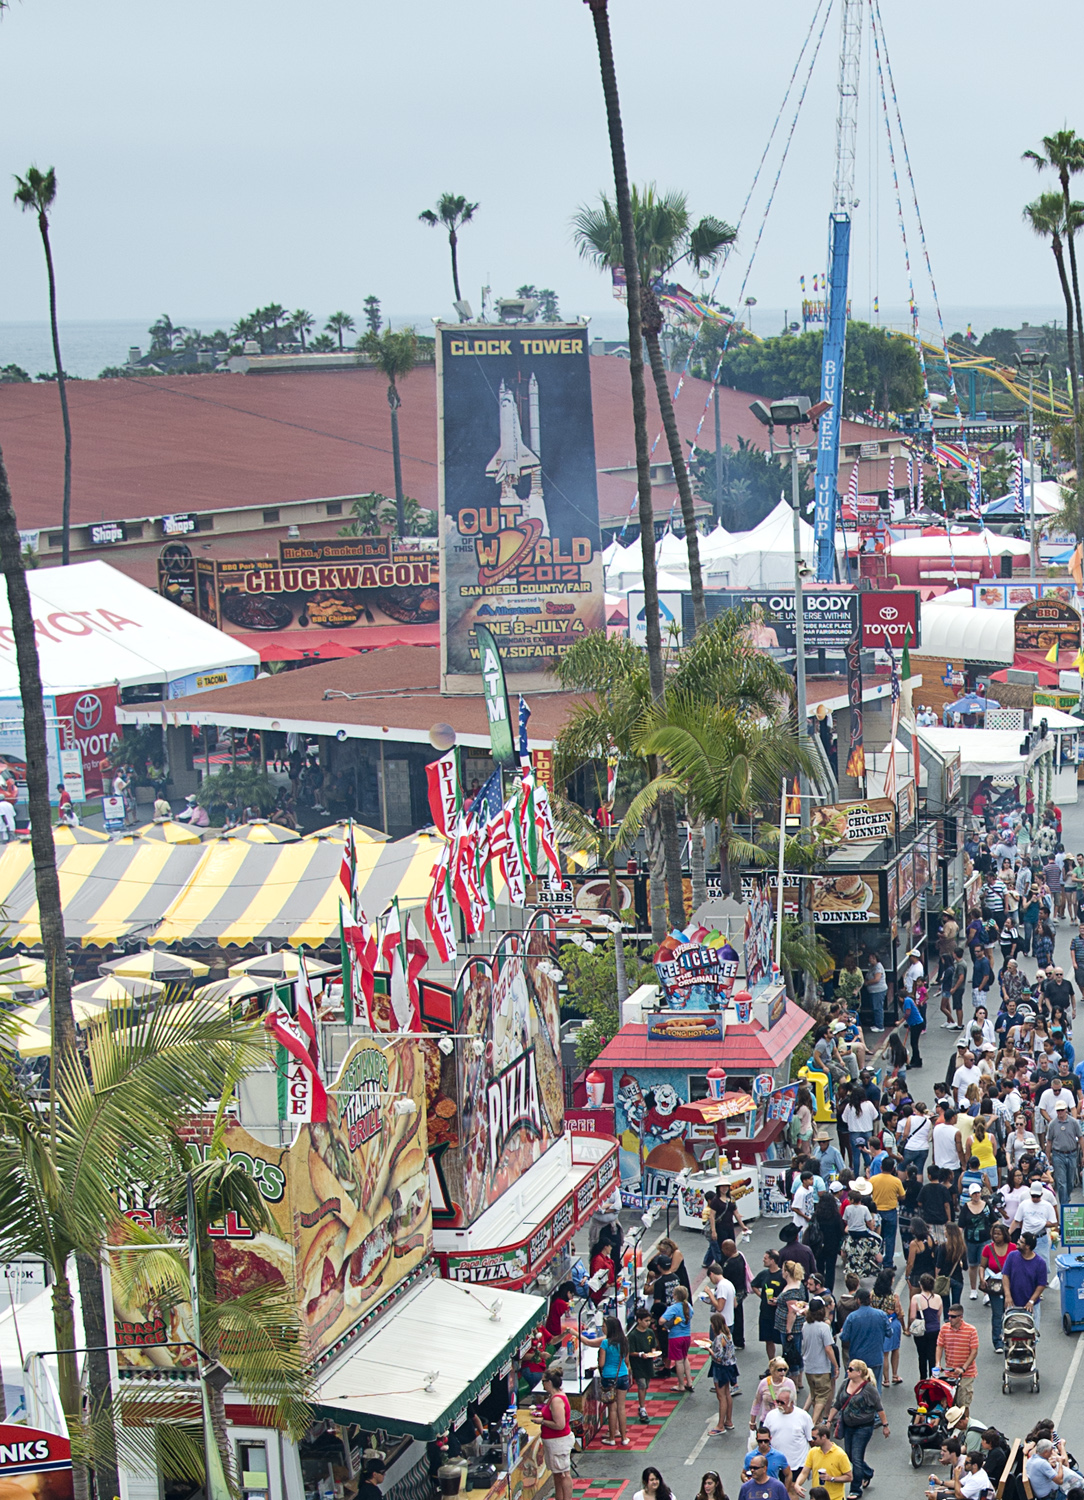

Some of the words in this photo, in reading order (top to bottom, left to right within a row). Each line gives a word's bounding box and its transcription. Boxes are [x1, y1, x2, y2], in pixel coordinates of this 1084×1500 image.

[451, 340, 512, 356] CLOCK
[521, 339, 583, 355] TOWER
[817, 476, 830, 537] JUMP
[165, 519, 195, 533] Shops
[458, 507, 521, 535] OUT
[92, 527, 123, 542] Shops
[324, 546, 362, 557] Smoked
[245, 564, 430, 594] CHUCKWAGON
[518, 565, 579, 582] 2012
[460, 586, 483, 596] SAN
[485, 585, 518, 595] DIEGO
[520, 583, 565, 594] COUNTY
[567, 582, 591, 592] FAIR
[494, 604, 541, 616] Albertsons
[808, 597, 851, 611] BODY
[329, 614, 357, 623] Chicken
[822, 612, 850, 620] WITHIN
[1036, 608, 1058, 618] BBQ
[572, 618, 585, 632] 4
[864, 624, 914, 634] TOYOTA
[204, 674, 228, 686] TACOMA
[483, 648, 506, 723] ATM
[848, 813, 892, 828] CHICKEN
[848, 826, 888, 840] DINNER
[539, 891, 573, 903] RIBS
[819, 911, 868, 923] DINNER
[657, 963, 681, 979] ICEE
[714, 962, 737, 978] ICEE
[676, 972, 693, 982] THE
[678, 974, 718, 988] ORIGINAL!
[652, 1027, 666, 1036] MILE
[668, 1029, 687, 1037] LONG
[688, 1029, 703, 1037] HOT
[704, 1028, 720, 1036] DOG
[347, 1083, 381, 1122] ITALIAN
[487, 1049, 543, 1170] PIZZA
[349, 1109, 382, 1151] GRILL
[460, 1259, 480, 1269] Papa
[481, 1255, 503, 1267] Gino's
[457, 1264, 508, 1283] PIZZA
